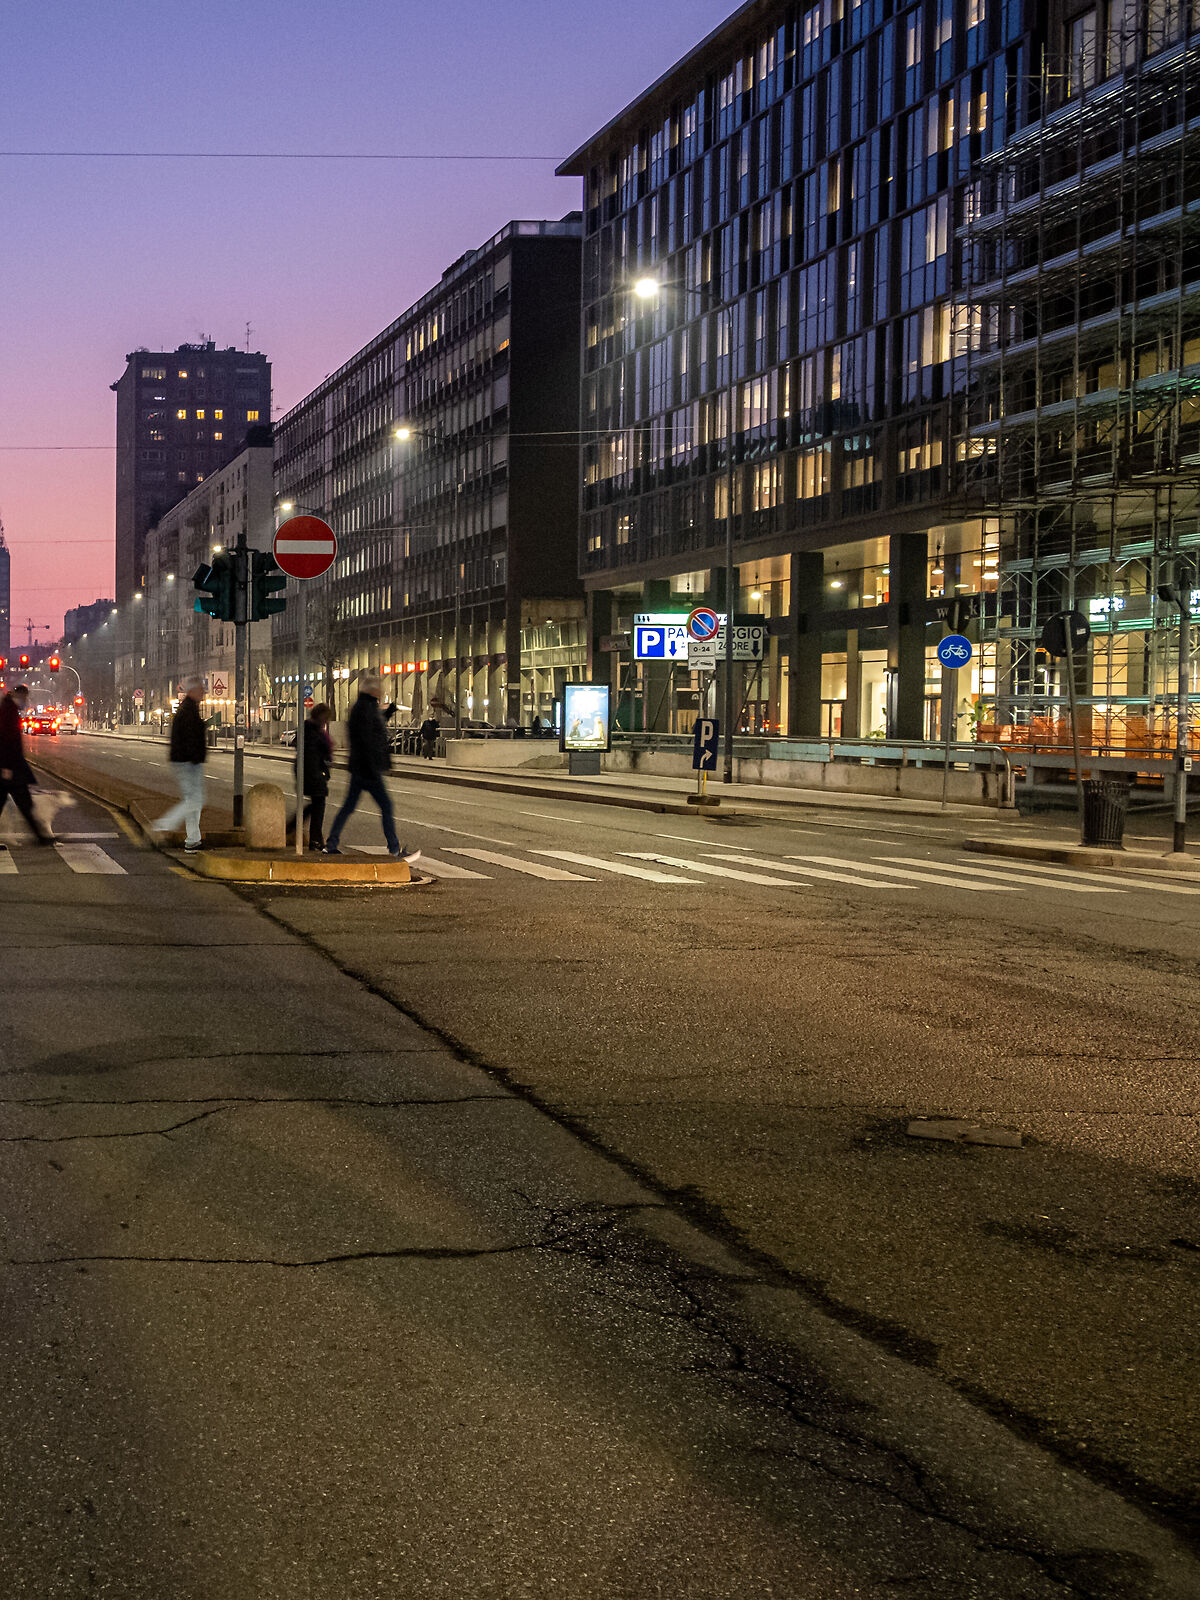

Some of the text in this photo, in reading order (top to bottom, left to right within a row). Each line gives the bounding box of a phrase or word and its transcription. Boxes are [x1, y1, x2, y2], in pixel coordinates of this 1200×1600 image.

[641, 631, 661, 655] P
[732, 642, 749, 650] ORE
[700, 720, 714, 748] P
